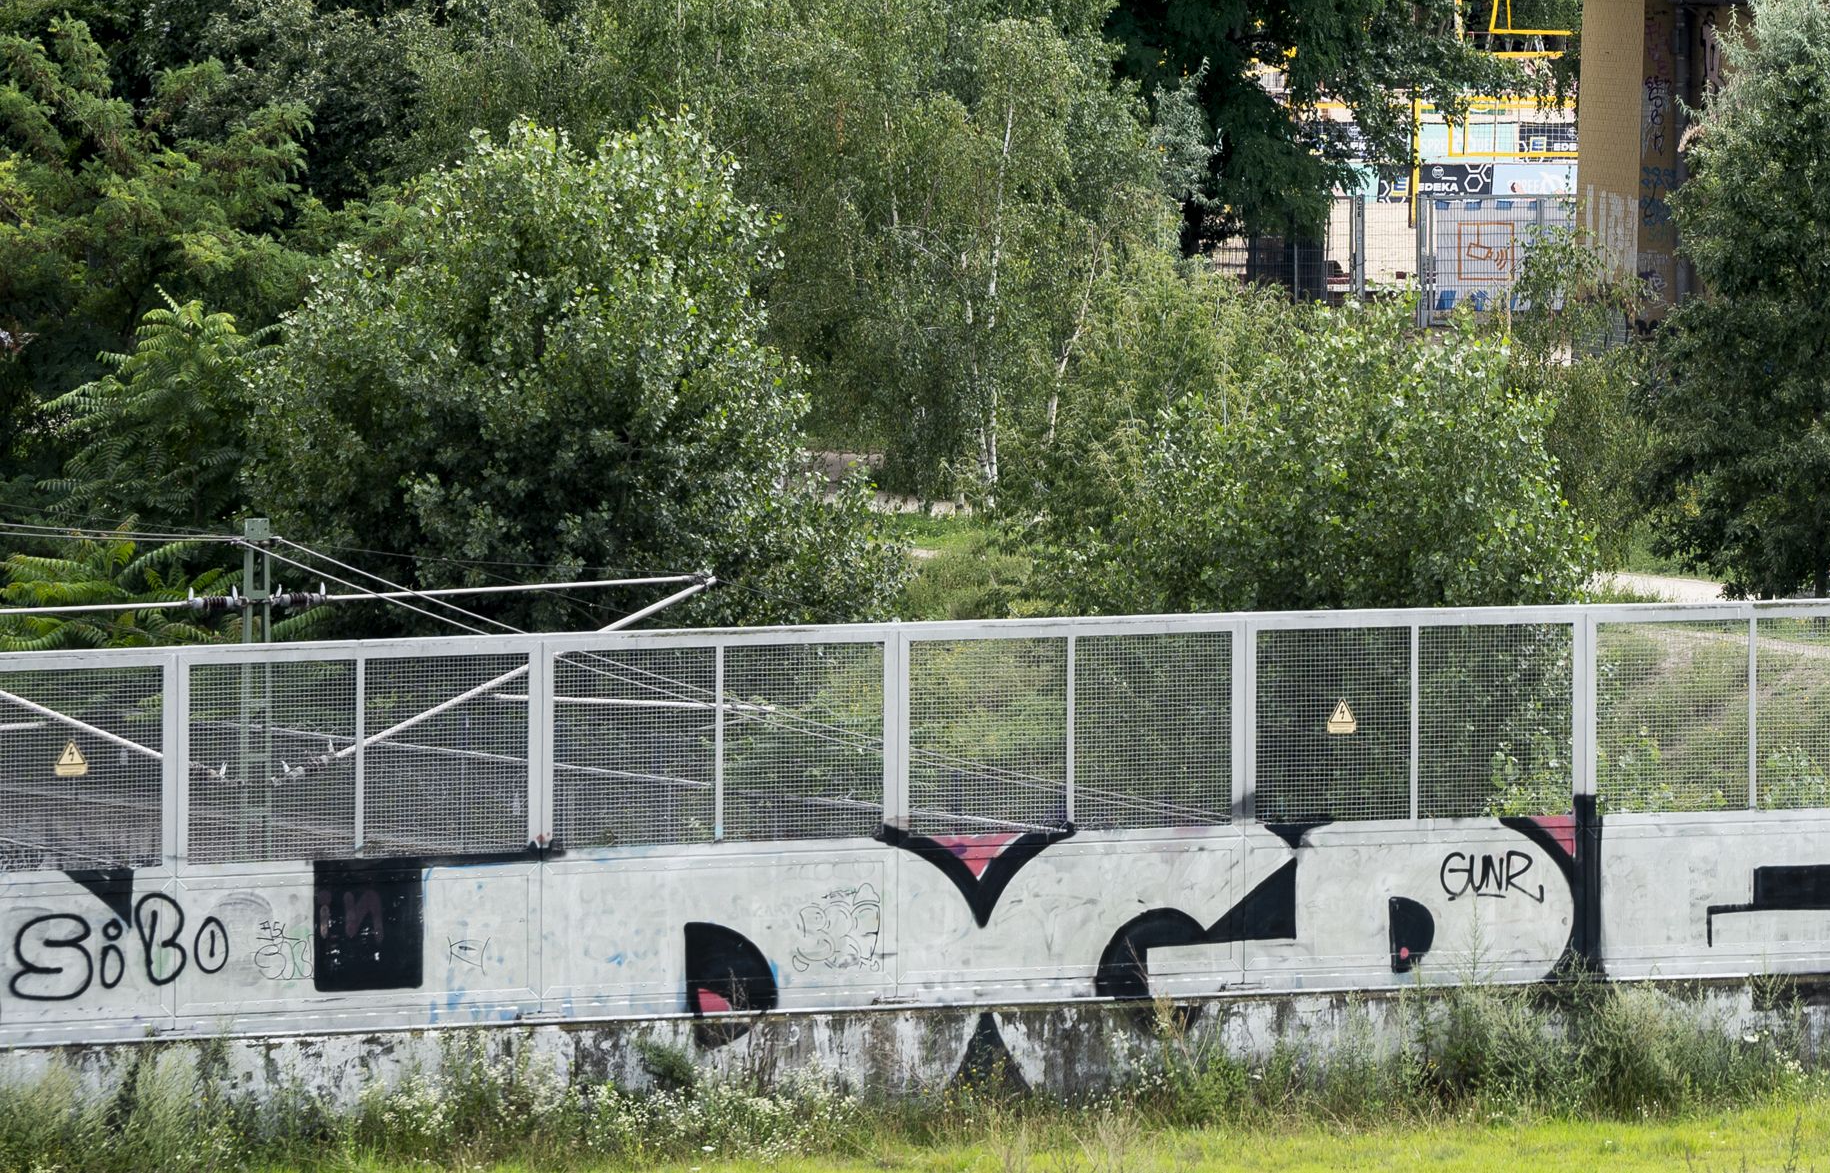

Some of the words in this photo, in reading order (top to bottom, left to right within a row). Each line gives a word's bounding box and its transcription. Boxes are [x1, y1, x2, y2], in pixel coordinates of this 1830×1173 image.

[1553, 142, 1578, 152] EDE
[1418, 182, 1459, 192] EDEKA
[1440, 850, 1545, 903] GUNR
